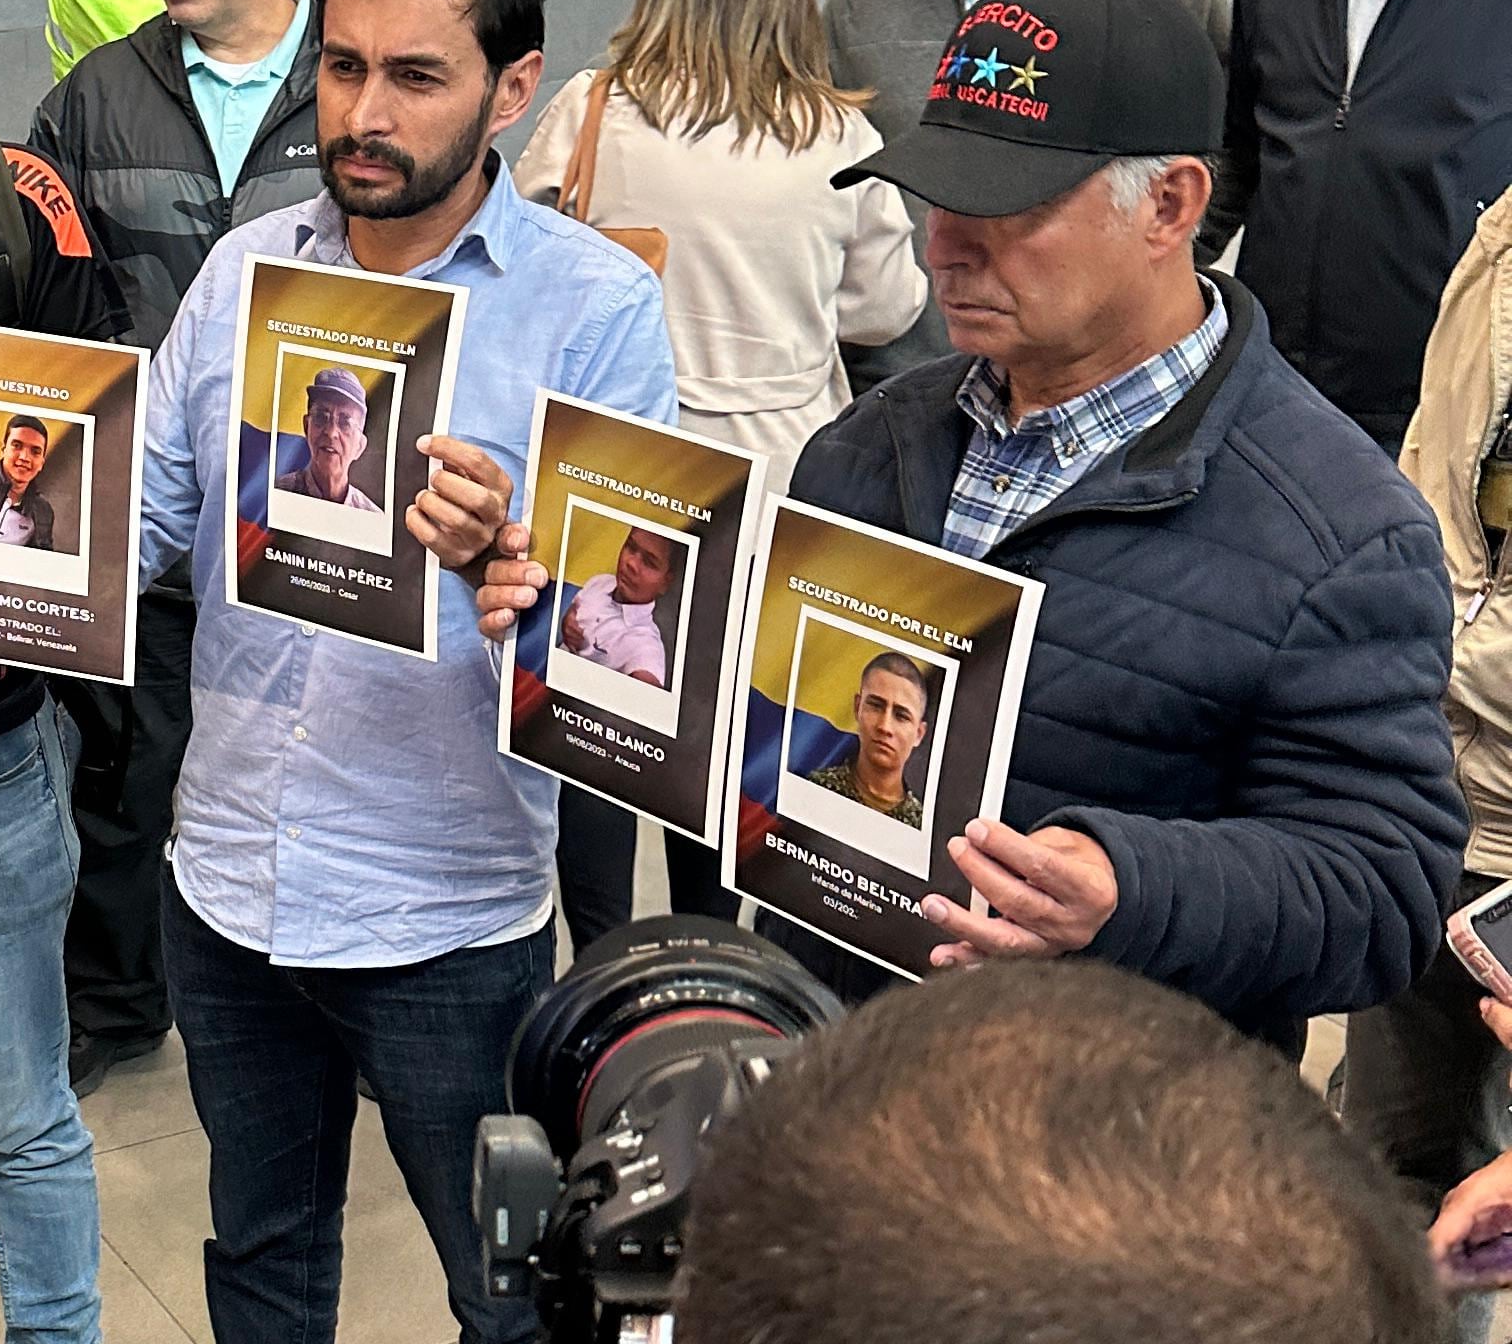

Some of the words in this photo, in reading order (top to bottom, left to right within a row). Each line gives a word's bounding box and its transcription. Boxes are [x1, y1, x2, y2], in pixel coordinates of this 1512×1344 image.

[957, 85, 1049, 121] USCATEGUI
[297, 144, 317, 155] Col
[9, 160, 71, 219] NIKE
[267, 319, 349, 344] SECUESTRADO
[350, 334, 374, 349] POR
[376, 340, 390, 352] EL
[393, 342, 416, 356] ELN
[557, 461, 641, 499] SECUESTRADO
[643, 489, 669, 508] POR
[670, 499, 685, 514] EL
[687, 504, 712, 522] ELN
[265, 547, 304, 568] SANIN
[308, 558, 346, 579] MENA
[348, 569, 393, 591] PÉREZ
[26, 600, 96, 623] CORTES:
[338, 588, 359, 601] Cesar
[788, 576, 888, 622] SECUESTRADO
[890, 612, 920, 634] POR
[922, 625, 941, 641] EL
[943, 631, 973, 652] ELN
[36, 637, 77, 653] Venezuela
[552, 704, 603, 737] VICTOR
[606, 727, 665, 762] BLANCO
[615, 754, 641, 772] Arauca
[765, 832, 855, 884] BERNARDO
[857, 875, 928, 920] BELTRA
[823, 895, 859, 919] 03/202
[853, 893, 883, 913] Marina
